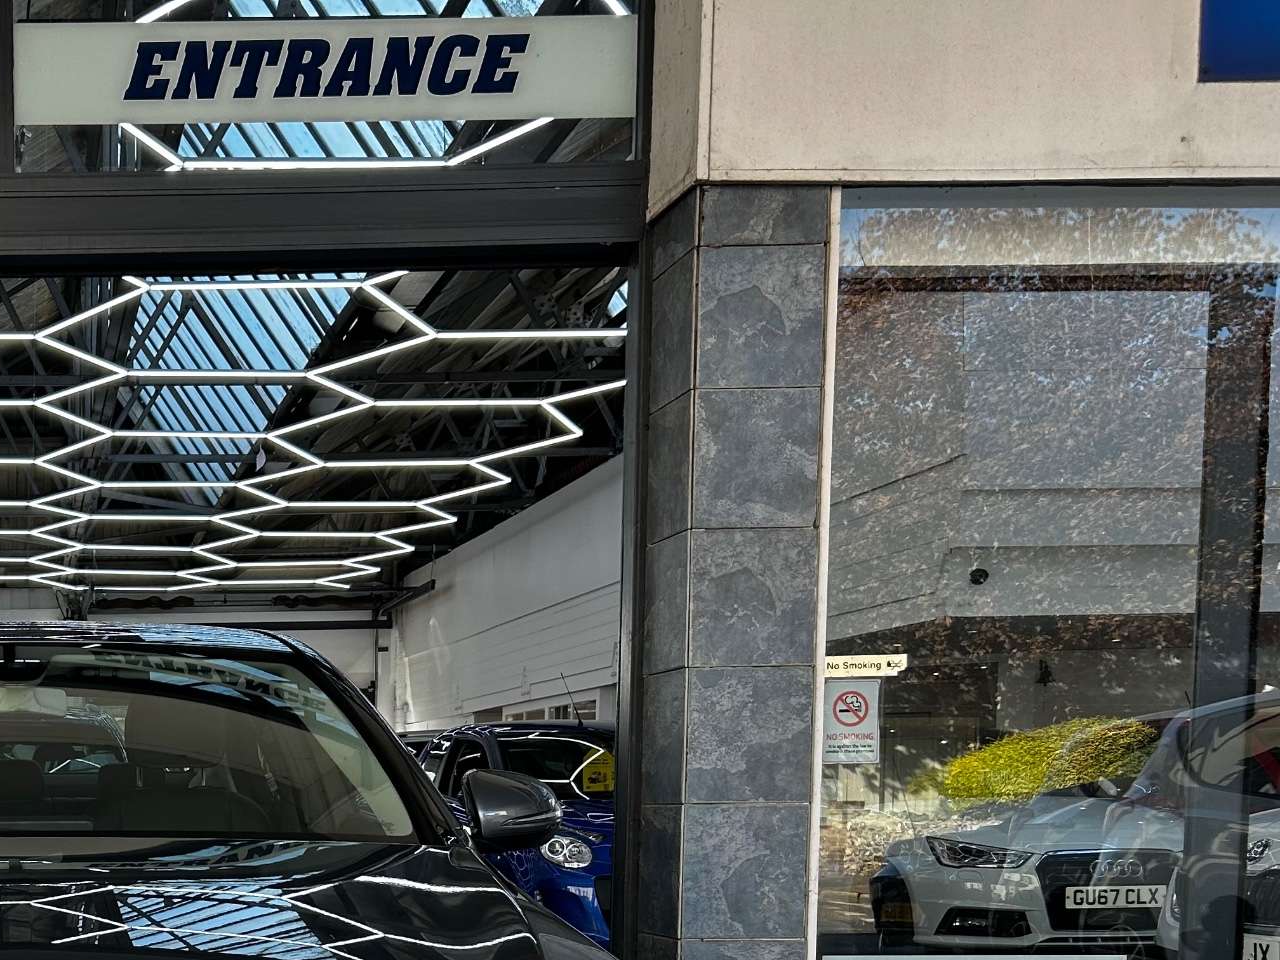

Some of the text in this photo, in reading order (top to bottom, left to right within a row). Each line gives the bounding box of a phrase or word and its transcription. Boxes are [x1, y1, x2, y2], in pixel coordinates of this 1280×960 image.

[123, 33, 531, 101] ENTRANCE
[826, 661, 882, 671] No Smoking
[826, 732, 874, 741] NO SMOKING
[1073, 887, 1159, 905] GU67 CLX
